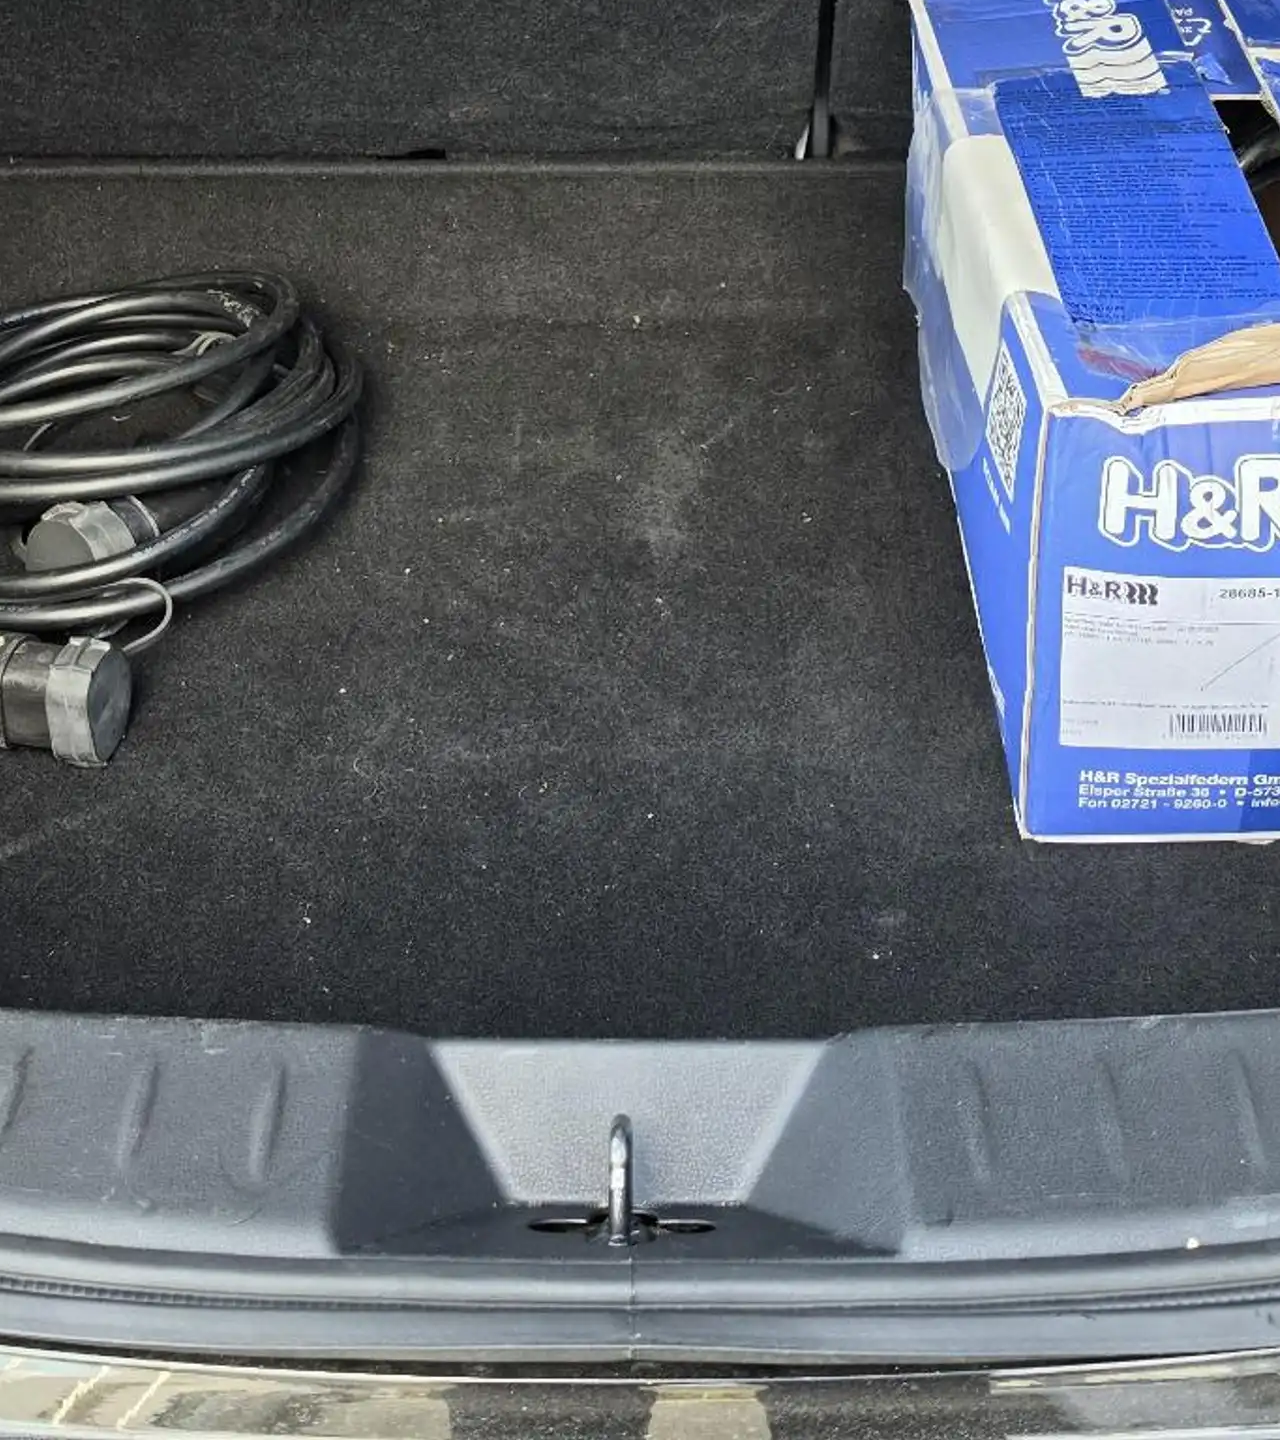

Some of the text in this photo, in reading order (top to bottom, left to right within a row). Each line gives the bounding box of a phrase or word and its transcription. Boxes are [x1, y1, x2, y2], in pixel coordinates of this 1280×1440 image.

[1080, 770, 1120, 784] H&R
[1124, 772, 1248, 786] Spezialfedern
[1133, 786, 1187, 798] Straße
[1078, 797, 1108, 808] Fon
[1111, 798, 1158, 809] 02721
